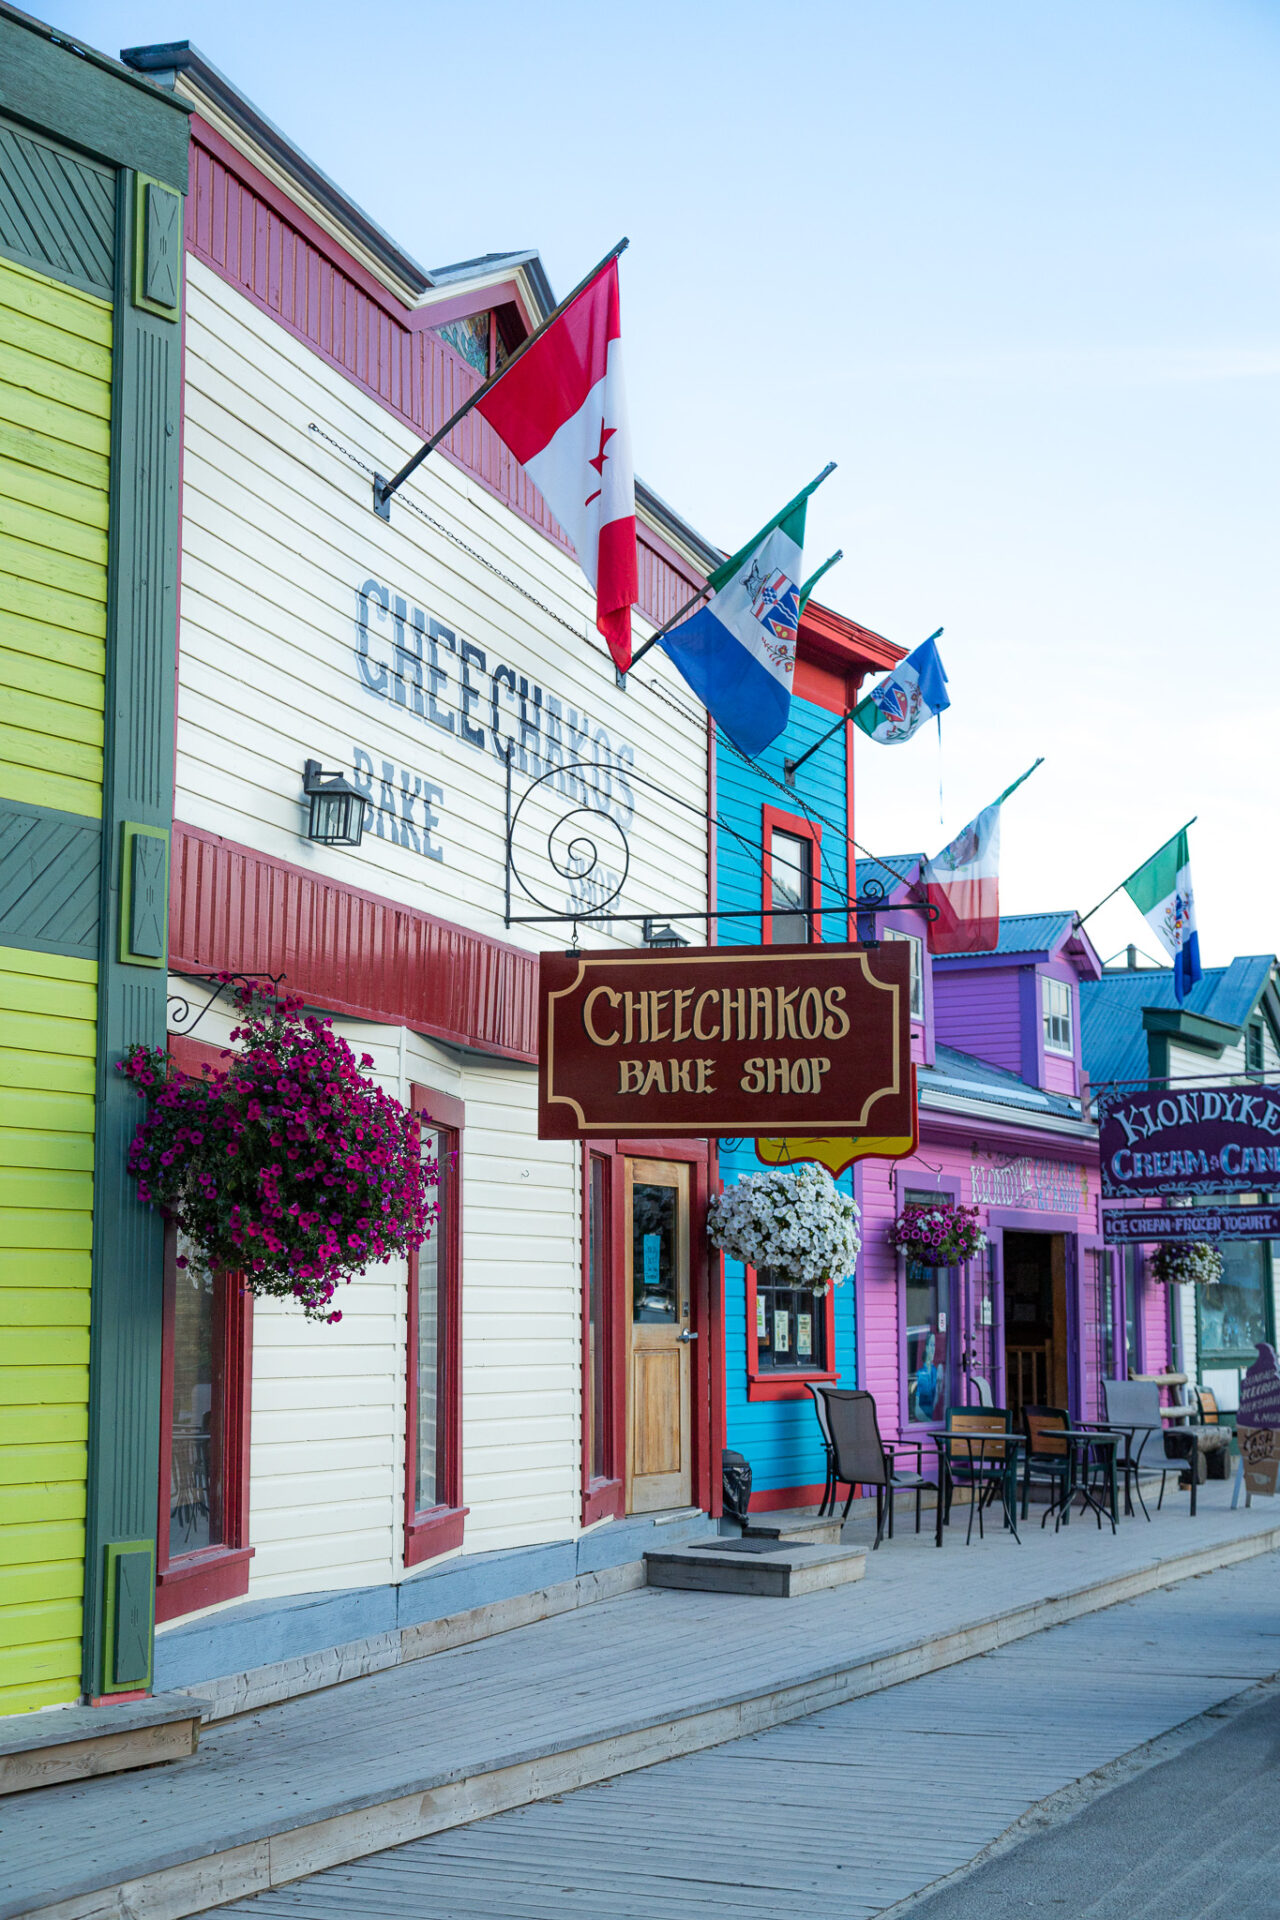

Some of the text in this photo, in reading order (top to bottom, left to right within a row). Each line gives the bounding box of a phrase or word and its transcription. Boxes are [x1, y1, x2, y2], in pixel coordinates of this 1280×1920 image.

[354, 579, 635, 833] CHEECHAKOS
[353, 747, 621, 936] BAKE SHOP
[582, 984, 851, 1047] CHEECHAKOS
[617, 1057, 832, 1095] BAKE SHOP
[1113, 1092, 1280, 1147] KLONDYKE
[970, 1157, 1033, 1206] KLONDYKE
[1111, 1148, 1210, 1181] CREAM
[1105, 1214, 1272, 1234] ICE CREAM FROZEN YOGURT
